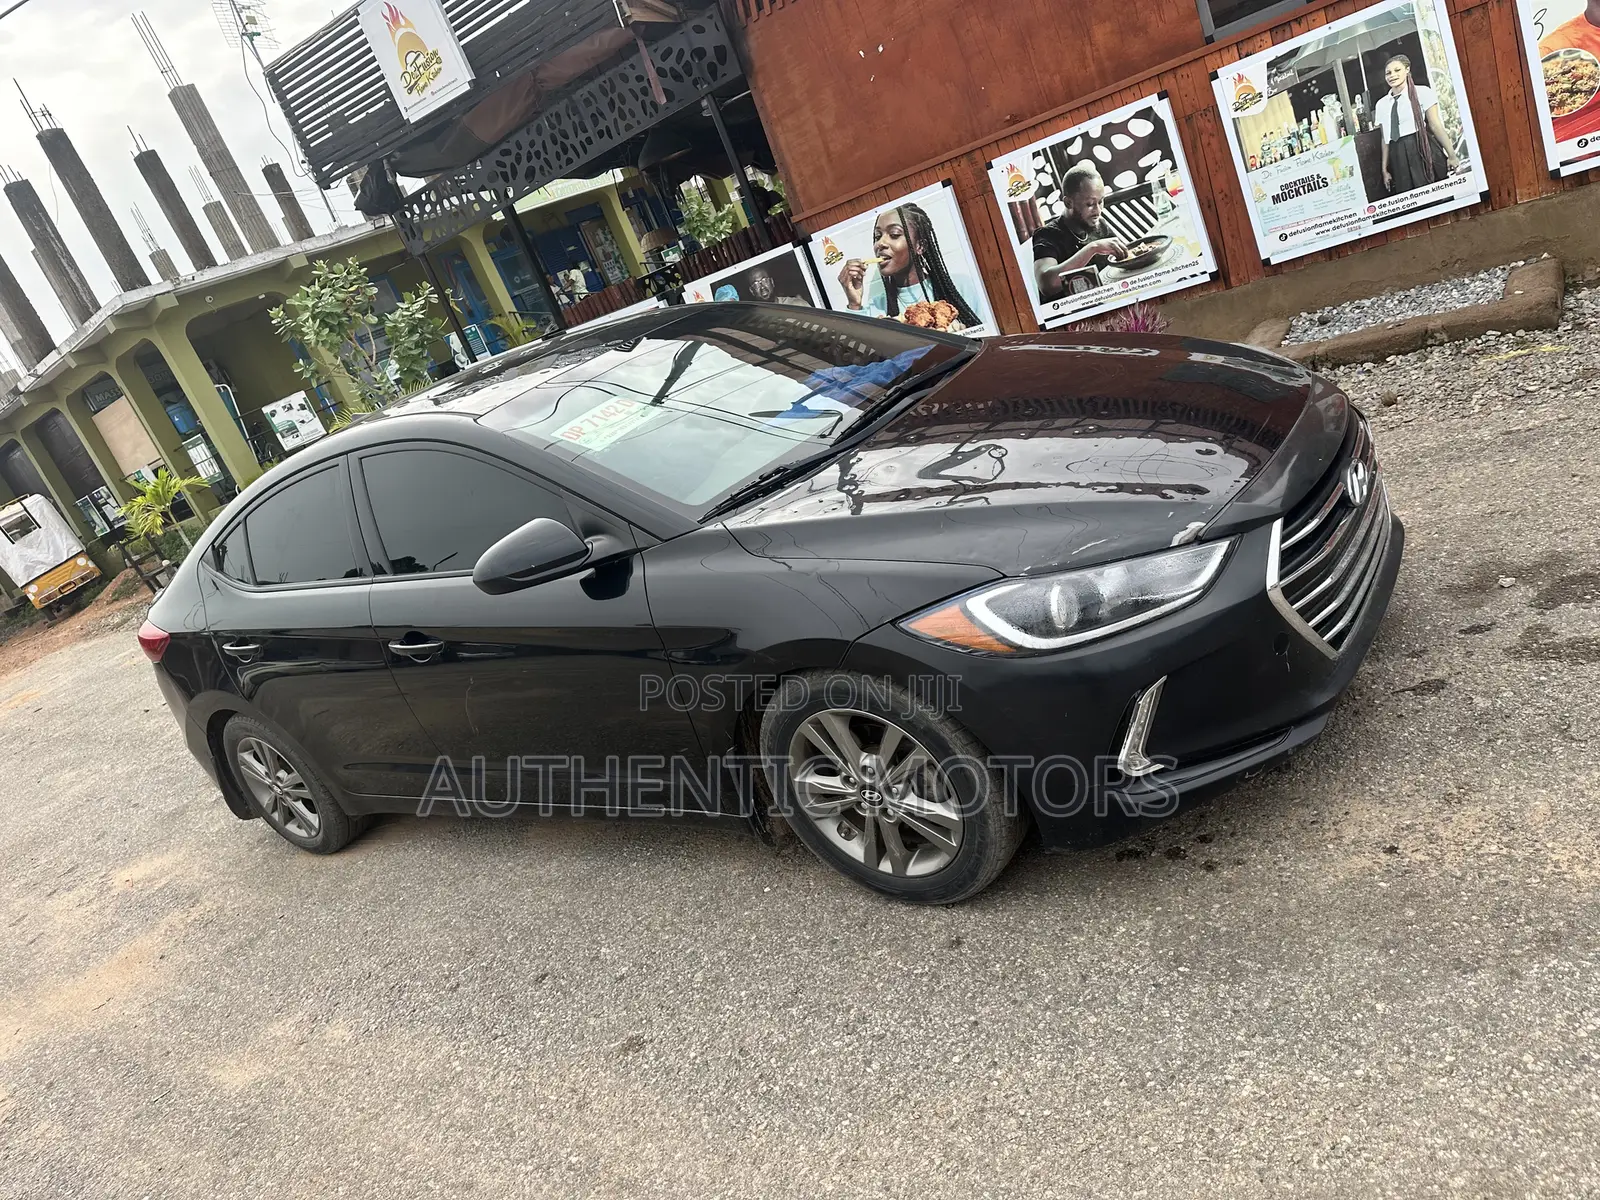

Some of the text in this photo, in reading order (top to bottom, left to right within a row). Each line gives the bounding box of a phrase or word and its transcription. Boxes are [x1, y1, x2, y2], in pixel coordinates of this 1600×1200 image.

[1271, 177, 1329, 205] MOCKTAILS
[1280, 174, 1316, 192] COCKTAILS
[1377, 177, 1467, 210] de.fusion.flame.kitchen25
